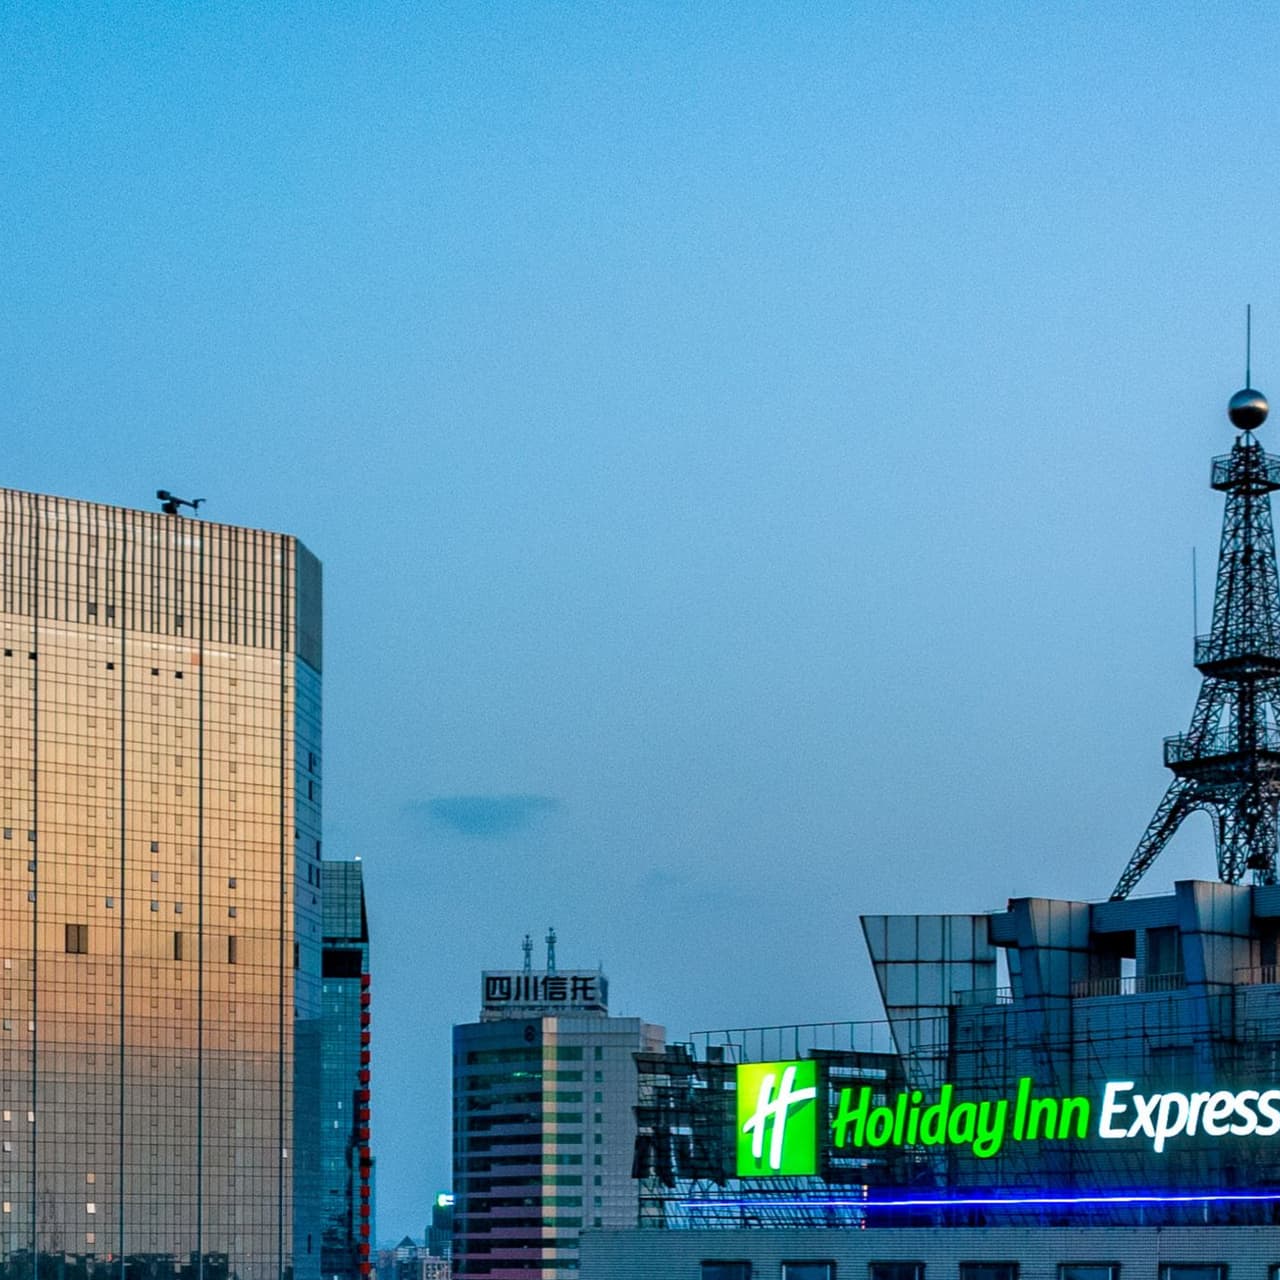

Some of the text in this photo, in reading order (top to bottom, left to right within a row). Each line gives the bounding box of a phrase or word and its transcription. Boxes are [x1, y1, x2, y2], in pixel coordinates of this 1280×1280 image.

[485, 975, 596, 1001] 四川信托
[831, 1083, 1009, 1159] Holiday
[1012, 1076, 1091, 1141] Inn
